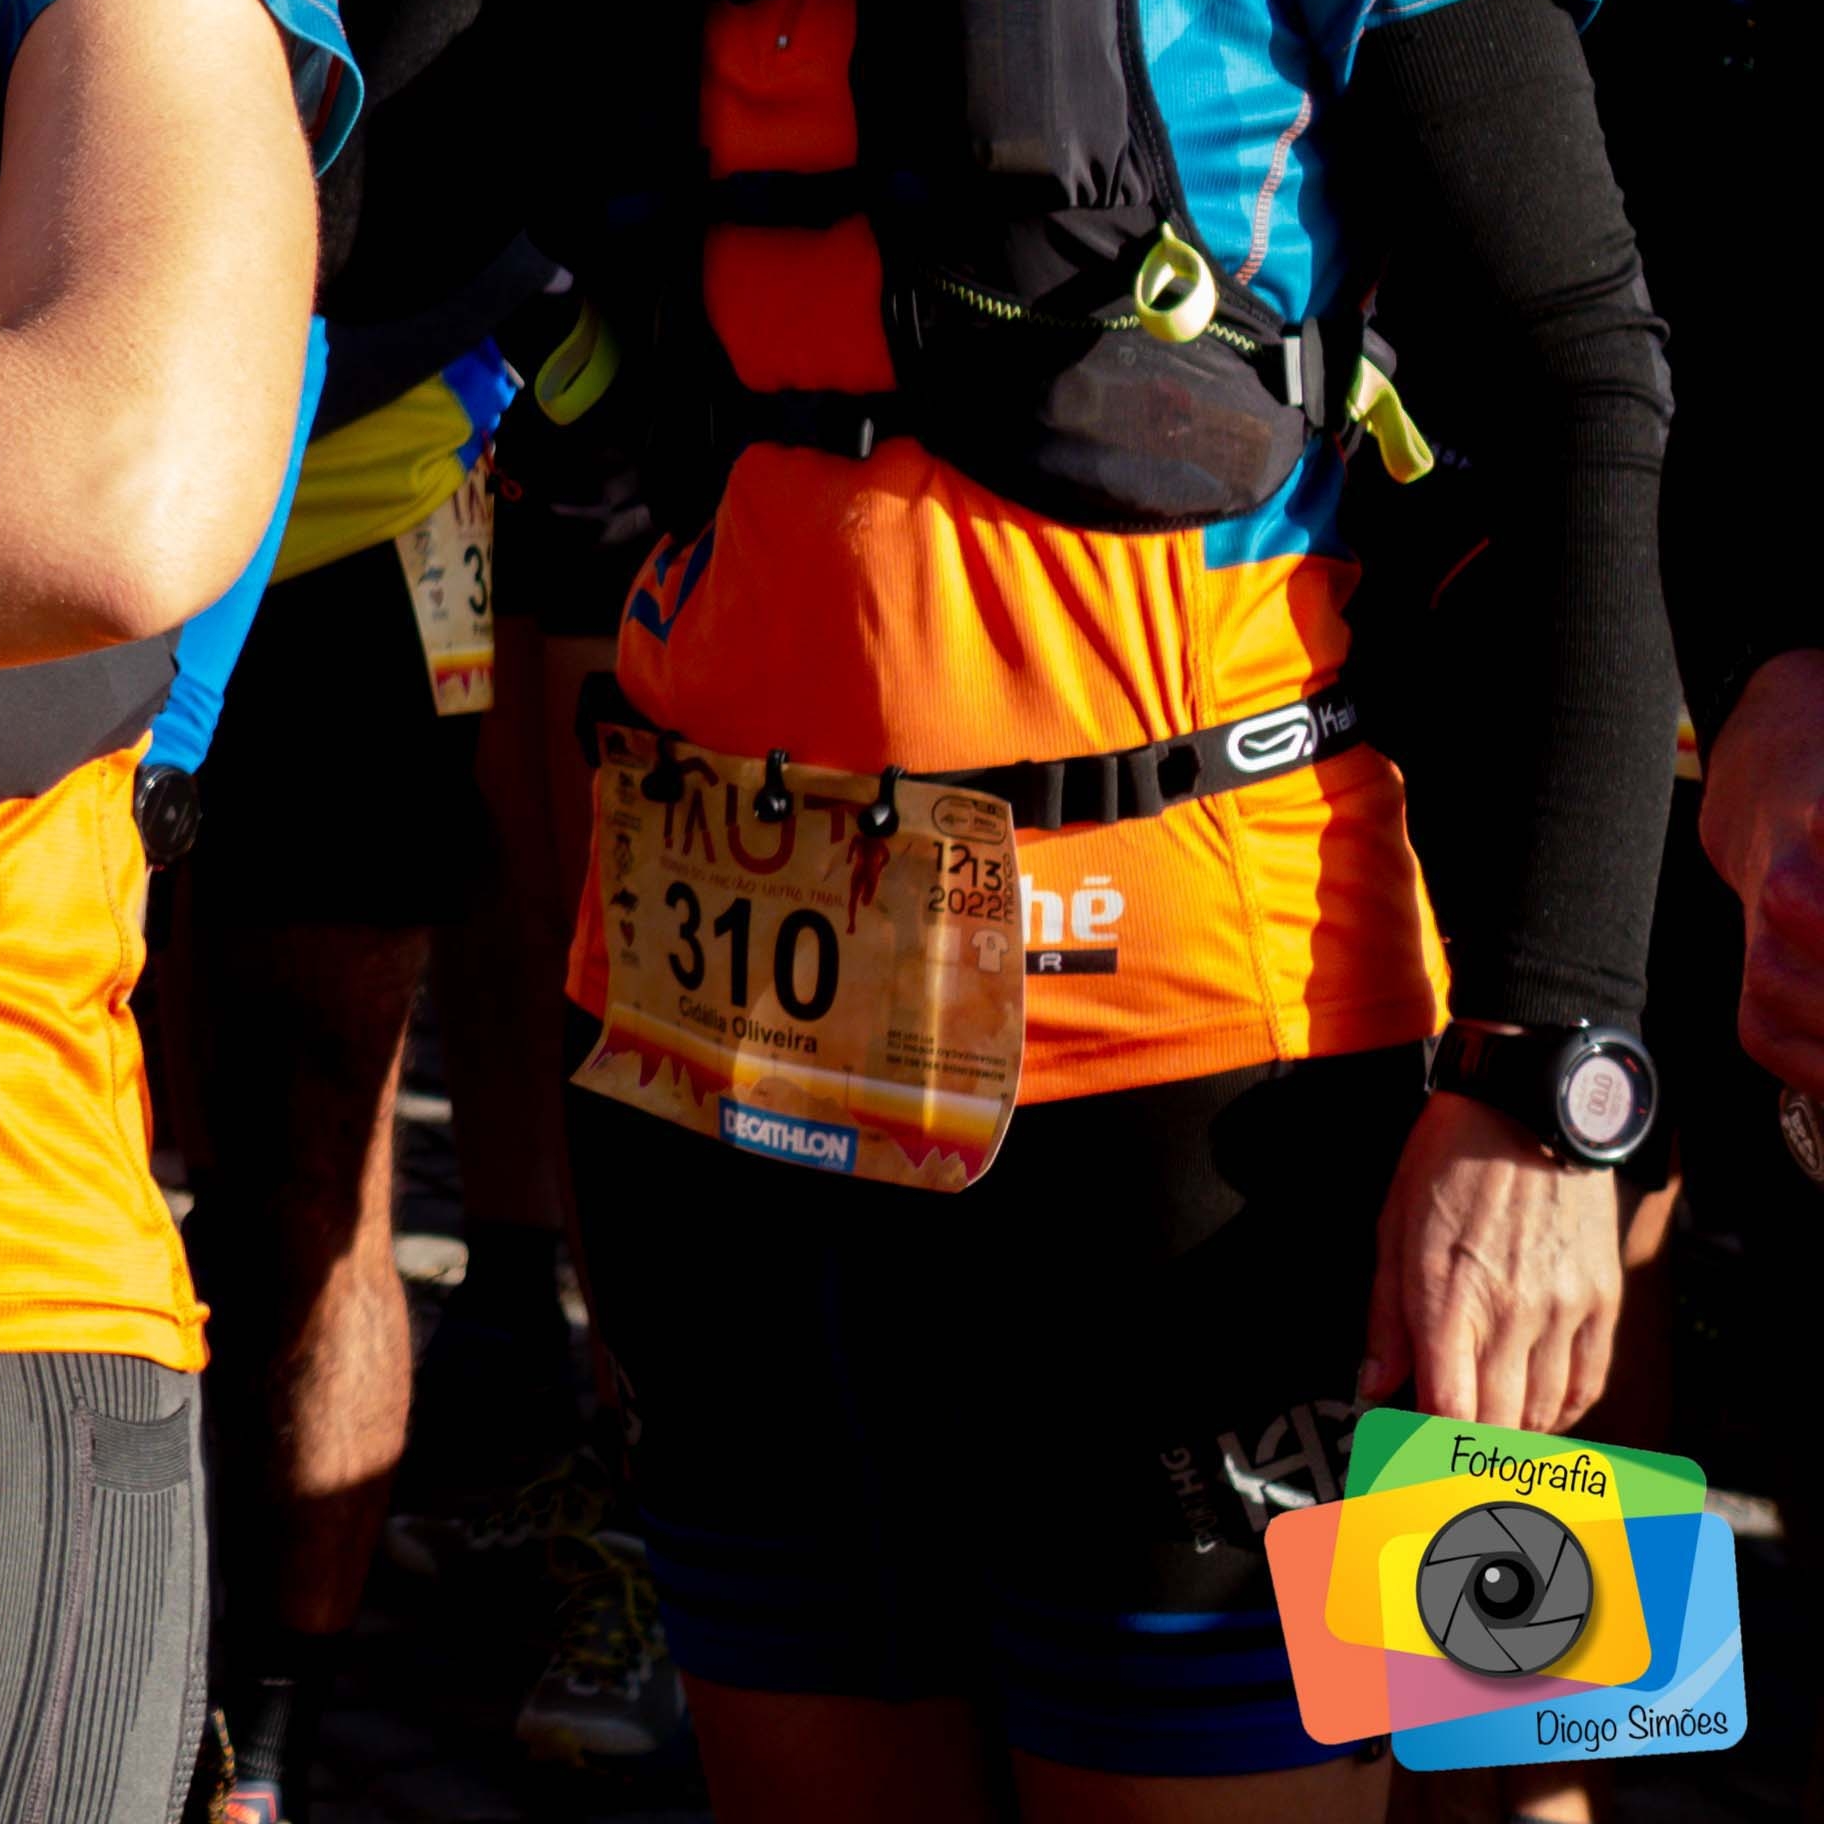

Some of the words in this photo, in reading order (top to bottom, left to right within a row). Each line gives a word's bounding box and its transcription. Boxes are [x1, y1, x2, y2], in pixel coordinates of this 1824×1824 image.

[928, 884, 1003, 922] 2022
[665, 881, 840, 1022] 310
[732, 1015, 818, 1054] Oliveira
[723, 1106, 851, 1162] DECATHLON
